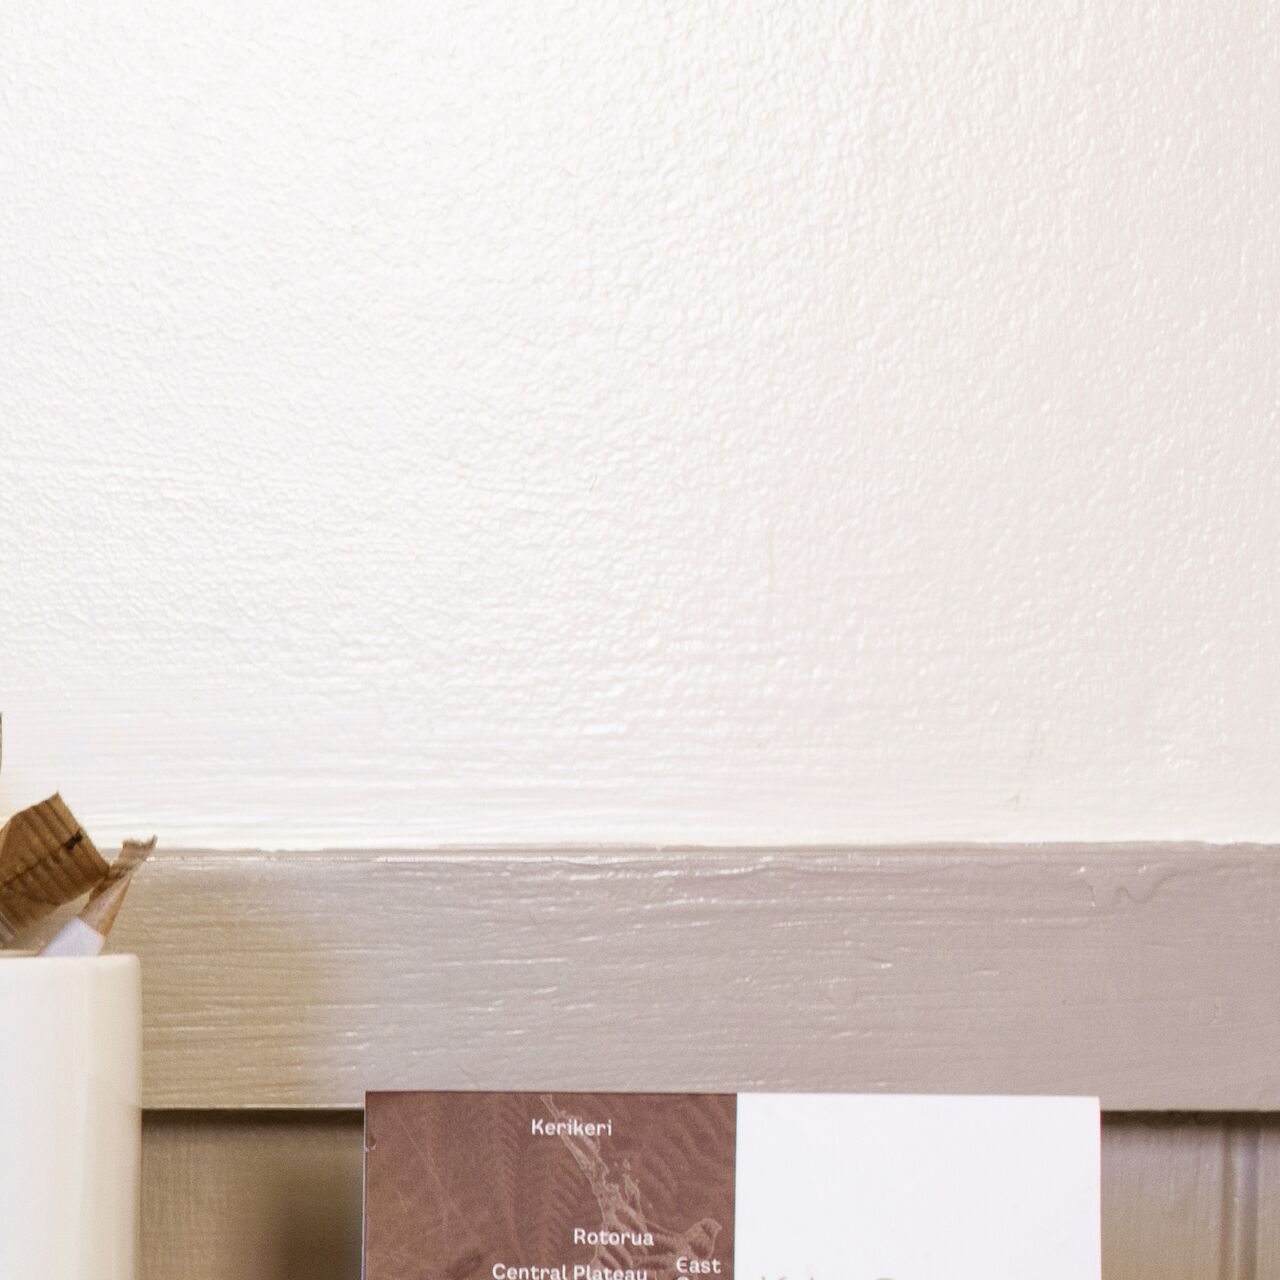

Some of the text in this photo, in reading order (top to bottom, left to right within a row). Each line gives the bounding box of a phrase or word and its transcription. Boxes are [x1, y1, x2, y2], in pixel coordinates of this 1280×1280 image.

[531, 1119, 613, 1137] Kerikeri
[573, 1229, 655, 1246] Rotorua
[492, 1263, 567, 1280] Central
[676, 1257, 721, 1274] East
